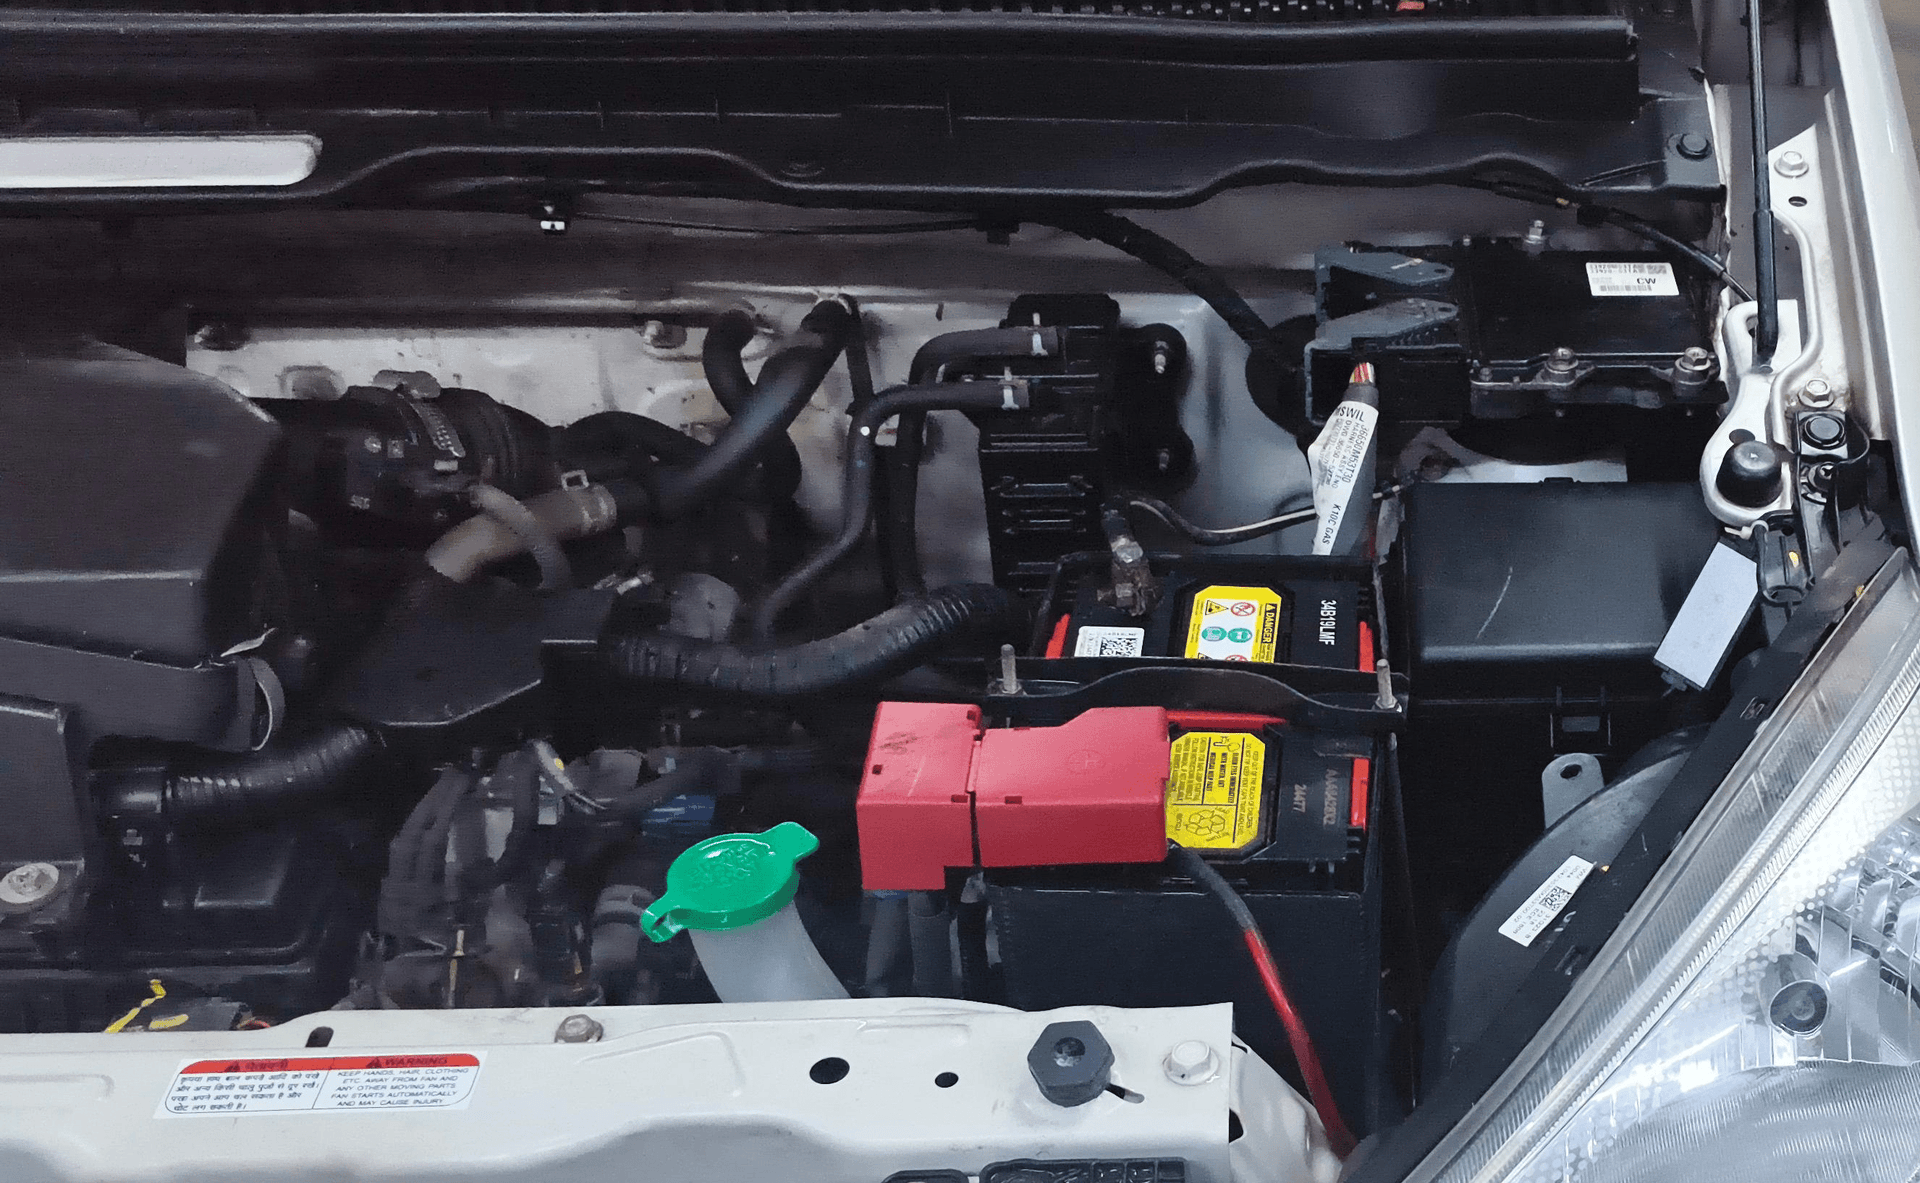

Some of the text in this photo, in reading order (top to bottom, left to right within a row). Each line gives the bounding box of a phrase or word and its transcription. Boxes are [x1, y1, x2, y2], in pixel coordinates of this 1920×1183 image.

[1342, 425, 1369, 484] 36650M53T30
[1322, 504, 1341, 544] K10C GAS
[1262, 612, 1276, 644] DANGER
[1319, 600, 1337, 646] 34B19LMF
[384, 1058, 448, 1066] WARNING
